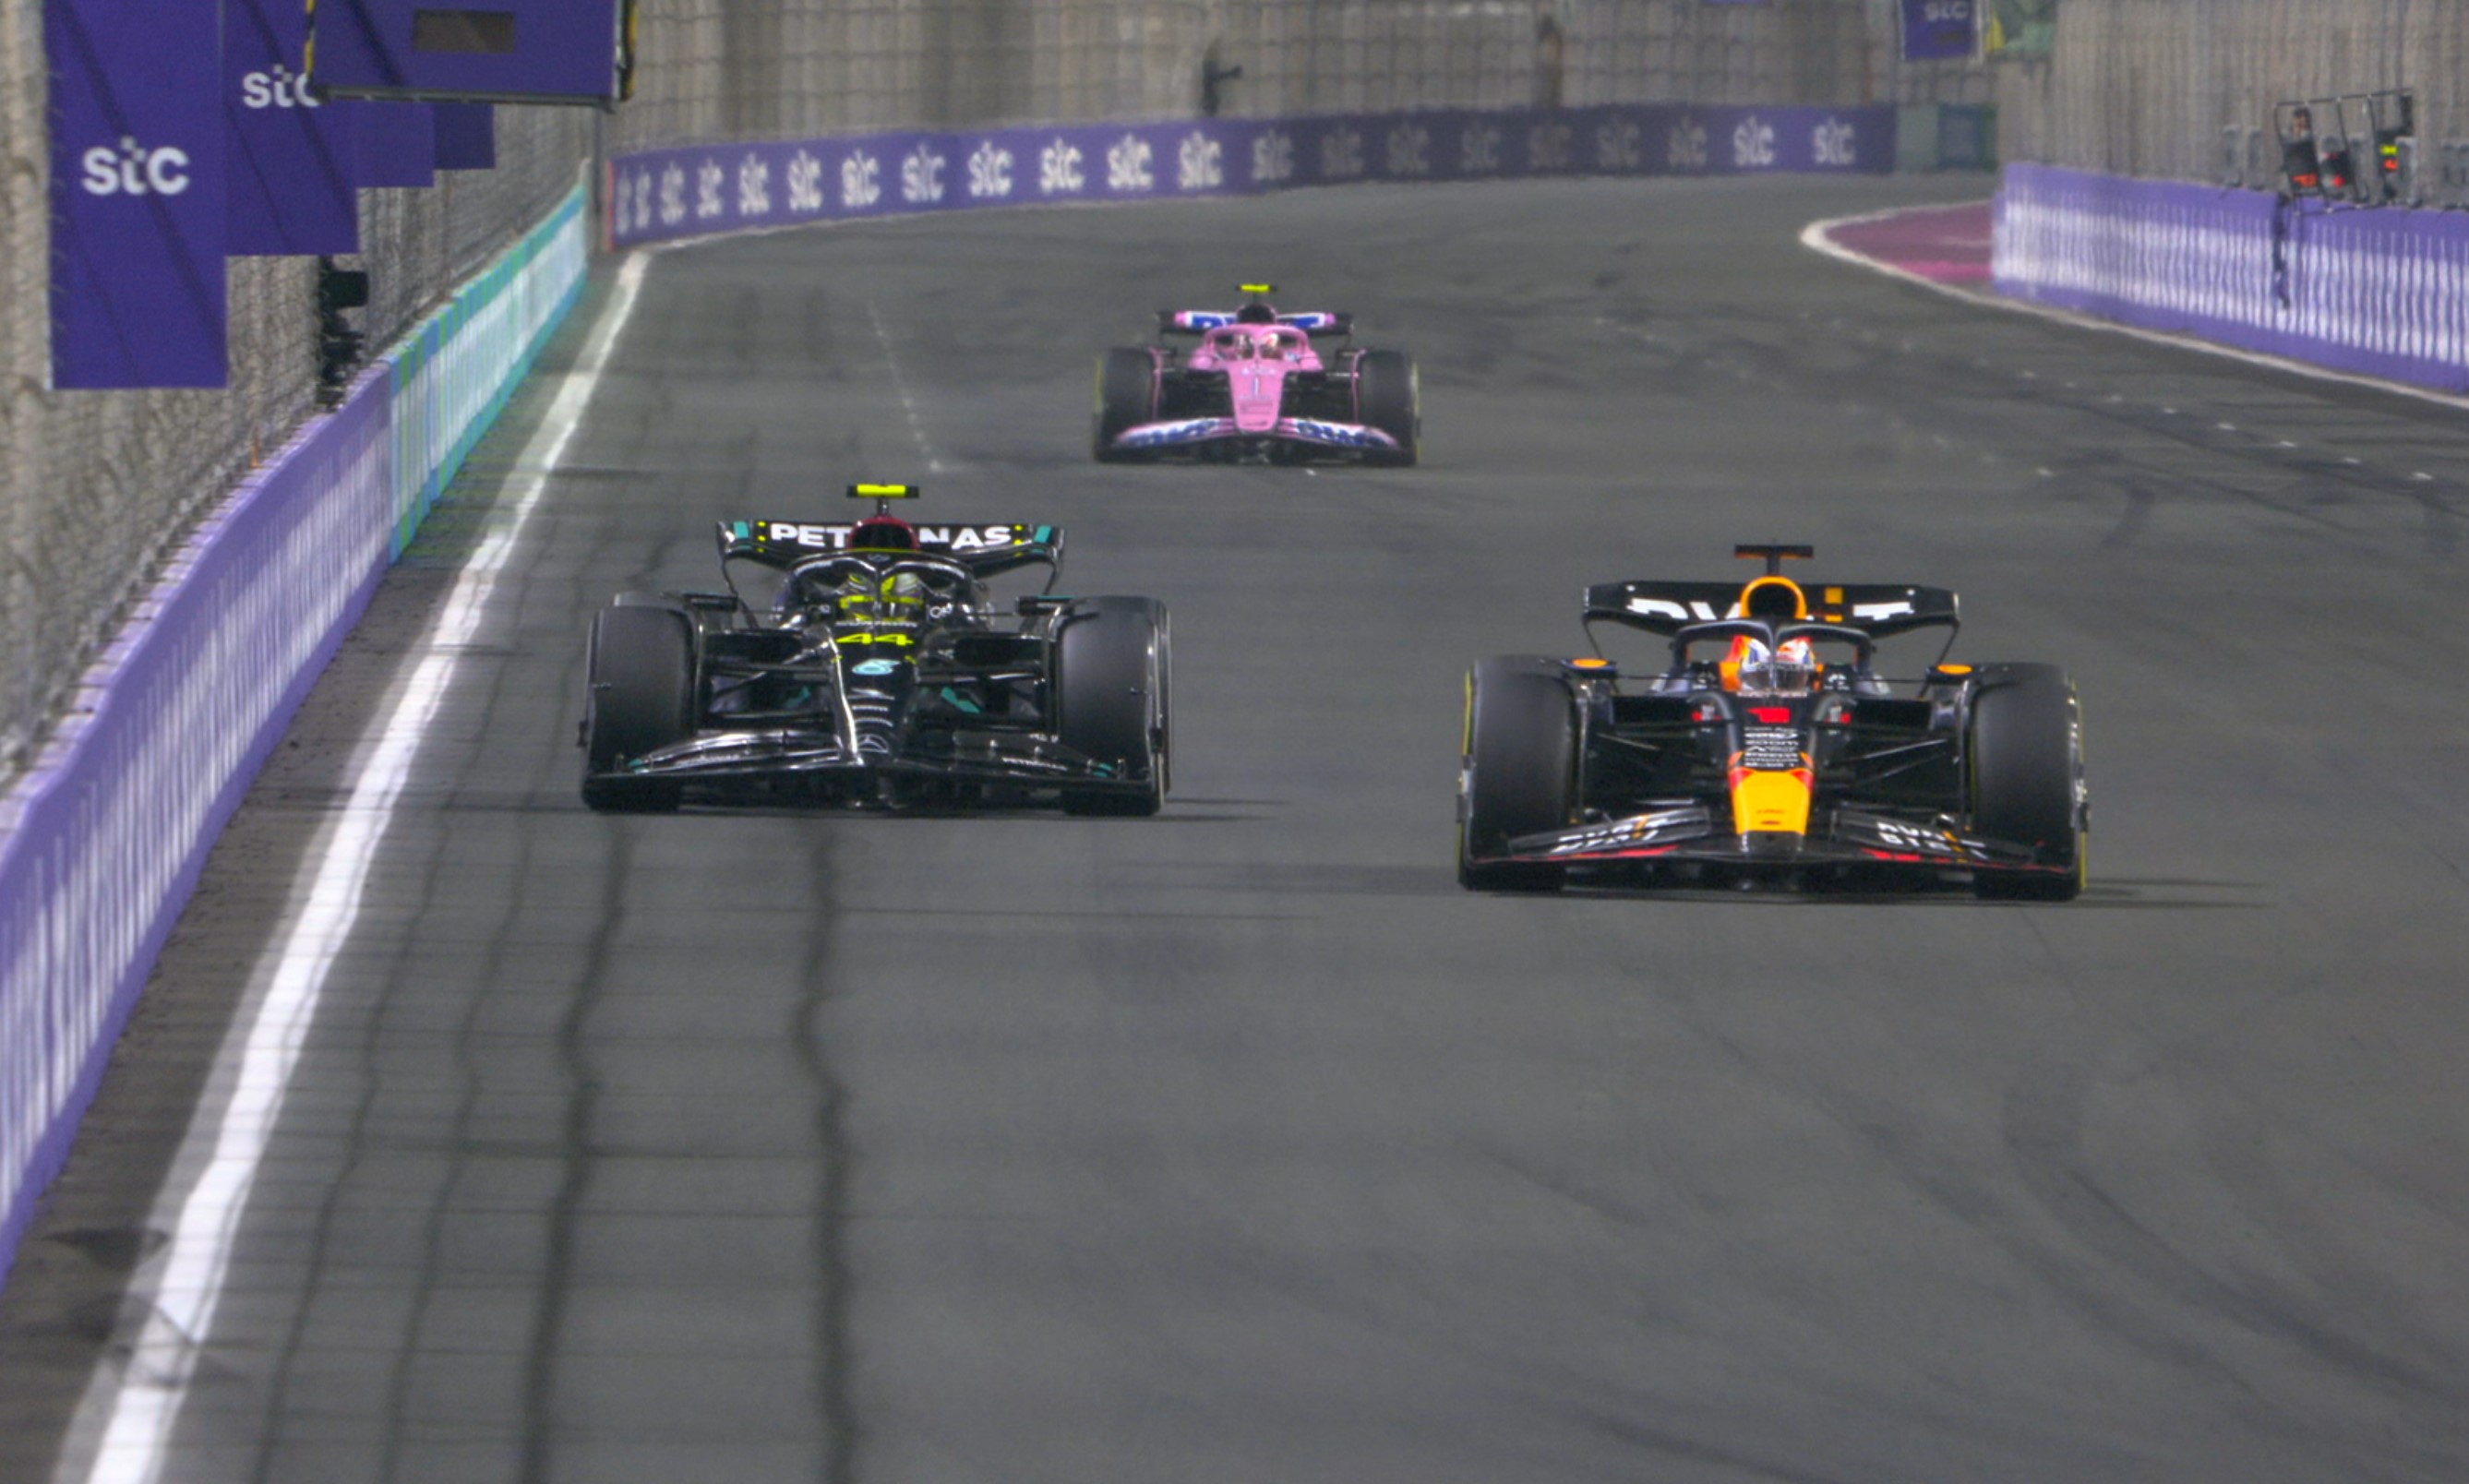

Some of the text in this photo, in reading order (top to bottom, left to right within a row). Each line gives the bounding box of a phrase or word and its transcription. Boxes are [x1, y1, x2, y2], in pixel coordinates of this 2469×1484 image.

[242, 63, 320, 108] stc
[82, 136, 190, 196] stc
[902, 142, 945, 202] stc
[969, 140, 1013, 197] stc
[1039, 138, 1085, 194] stc
[1733, 115, 1775, 167] stc
[1813, 115, 1856, 166] stc
[770, 522, 1013, 550] PETNAS
[836, 633, 914, 646] 44
